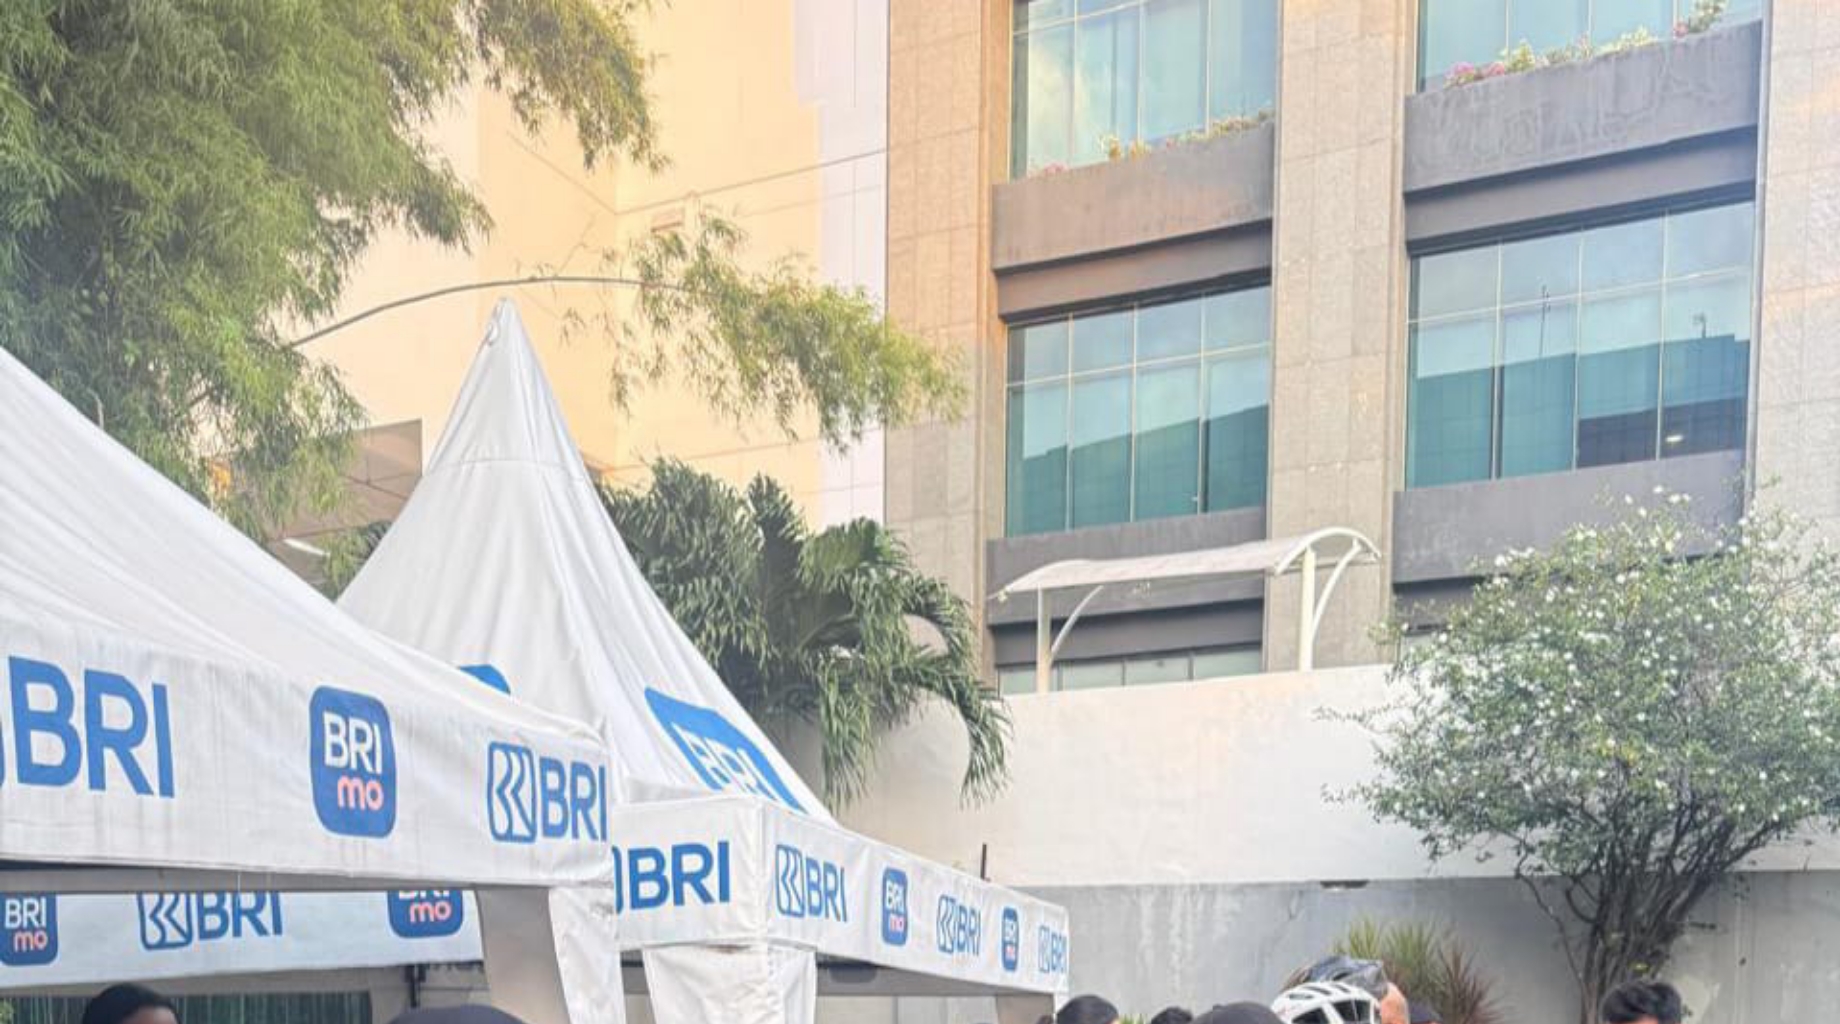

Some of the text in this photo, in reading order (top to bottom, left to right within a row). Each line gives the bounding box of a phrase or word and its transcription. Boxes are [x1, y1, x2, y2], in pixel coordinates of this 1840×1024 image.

[8, 655, 174, 798] BRI
[323, 711, 382, 774] BRI
[671, 721, 787, 808] BRI
[337, 775, 383, 811] mo
[539, 756, 607, 842] BRI
[627, 841, 730, 910] BRI
[806, 857, 847, 922] BRI
[886, 879, 905, 914] BRI
[5, 898, 47, 929] BRI
[197, 891, 283, 939] BRI
[409, 901, 452, 922] mo
[957, 904, 981, 956] BRI
[14, 930, 48, 952] mo
